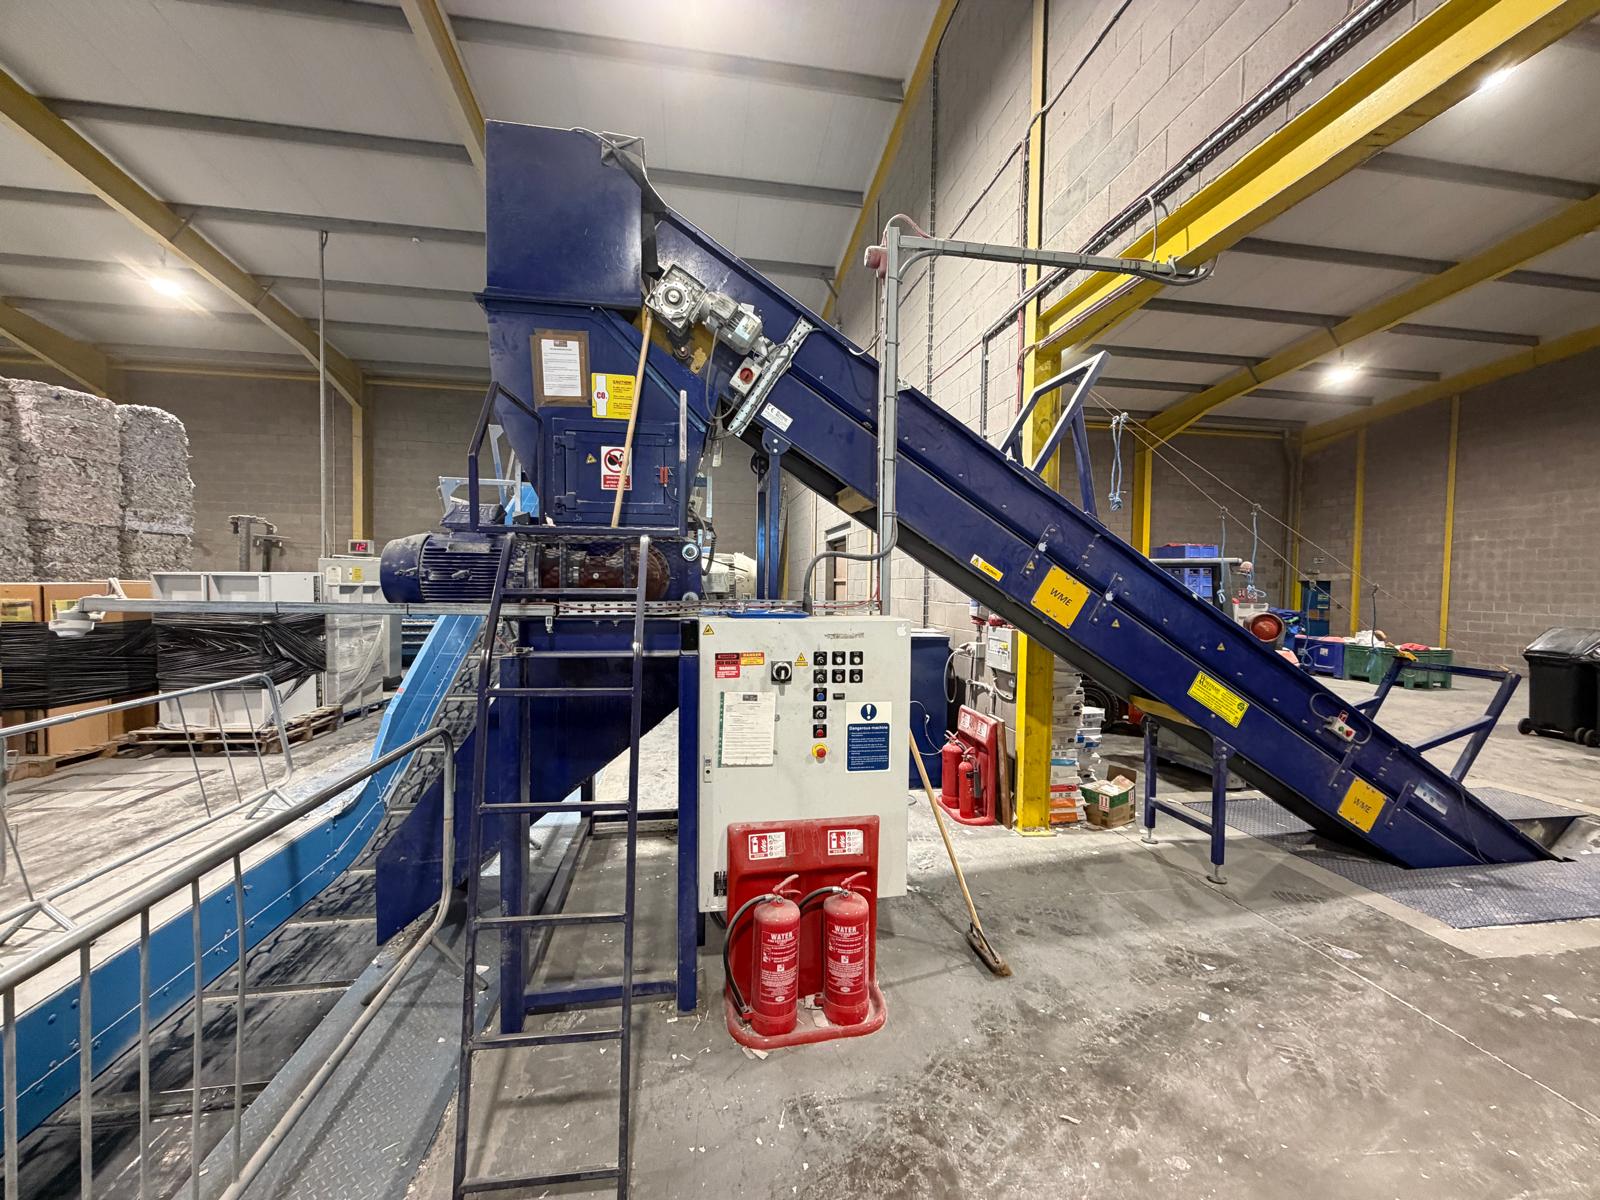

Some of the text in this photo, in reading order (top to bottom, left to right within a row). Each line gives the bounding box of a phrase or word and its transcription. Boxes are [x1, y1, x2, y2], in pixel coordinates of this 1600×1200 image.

[1050, 587, 1073, 607] WME
[1353, 796, 1372, 814] WME
[770, 931, 793, 941] WATER
[834, 925, 857, 933] WATER
